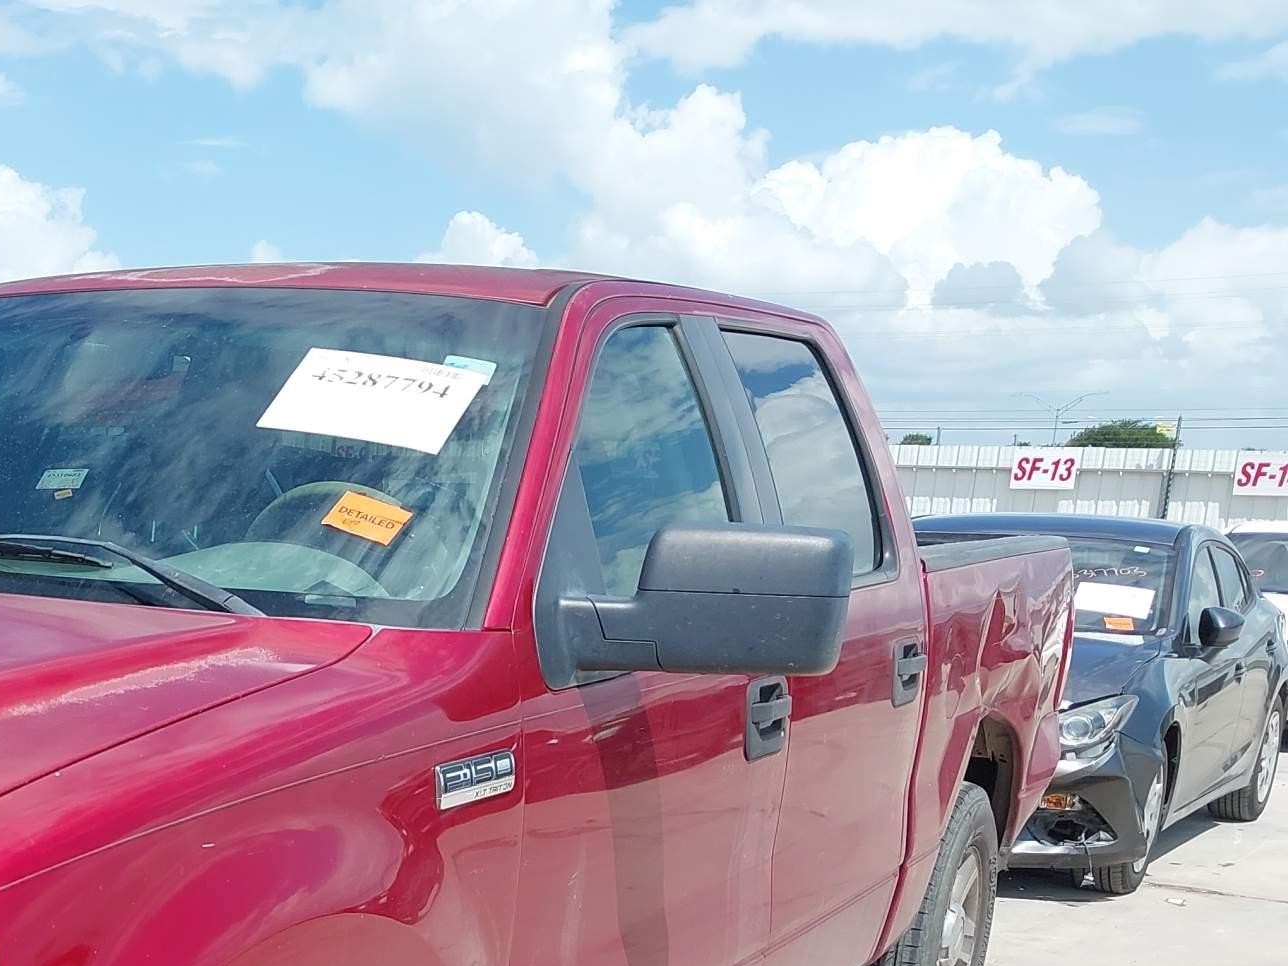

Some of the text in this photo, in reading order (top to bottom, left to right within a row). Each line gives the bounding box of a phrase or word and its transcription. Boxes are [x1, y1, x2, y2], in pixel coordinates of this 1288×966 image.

[312, 367, 451, 398] 45287794
[1013, 456, 1076, 482] SF-13
[1237, 461, 1288, 487] SF-1
[338, 505, 396, 530] DETAILED
